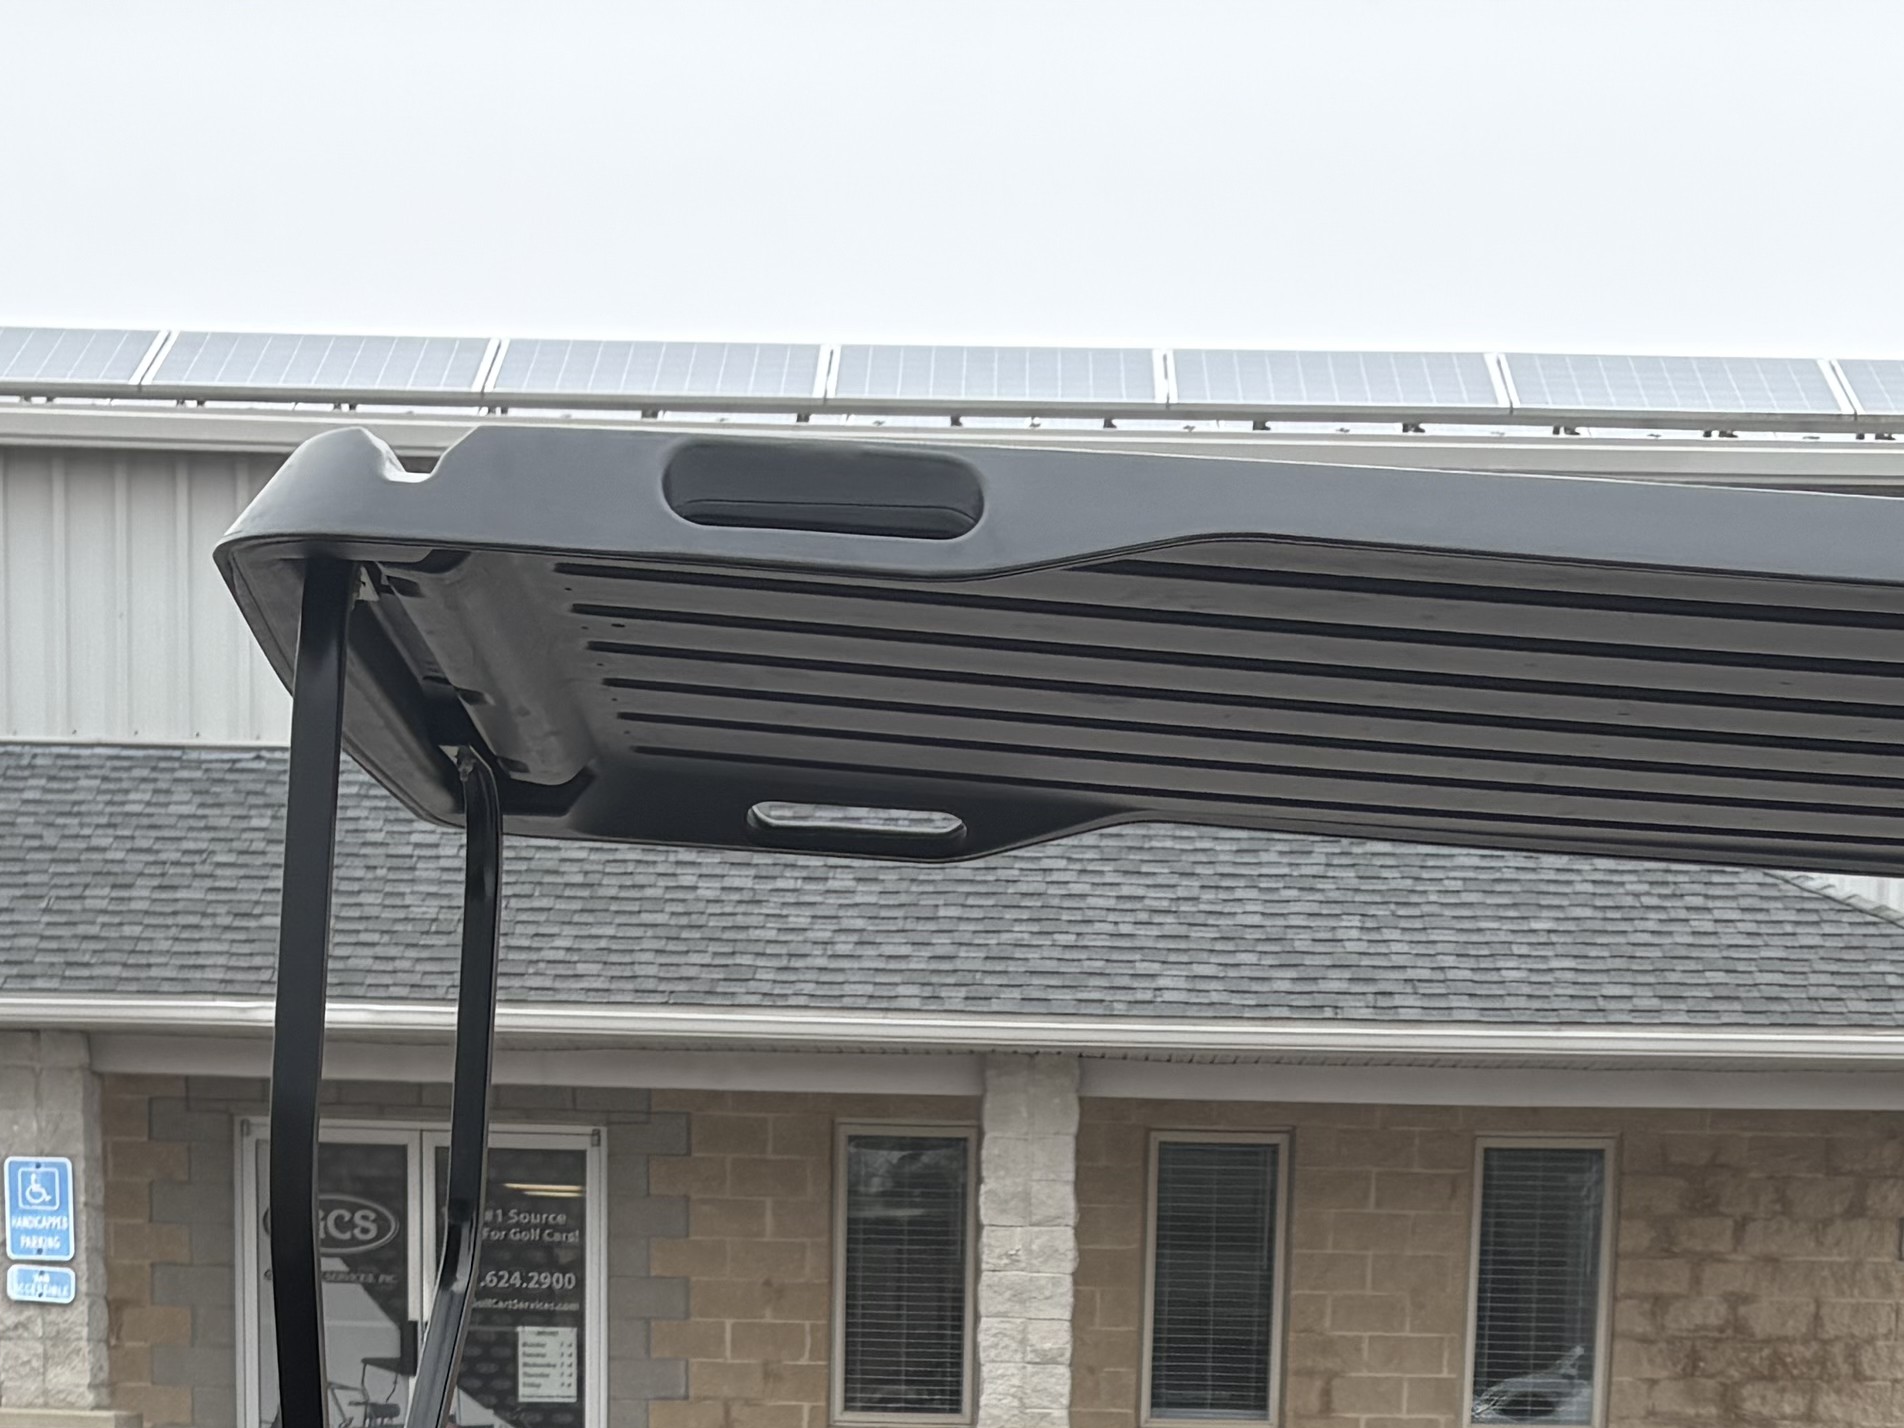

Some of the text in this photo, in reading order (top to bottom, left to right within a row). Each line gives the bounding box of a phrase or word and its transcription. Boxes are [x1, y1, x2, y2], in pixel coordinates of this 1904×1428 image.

[319, 1208, 379, 1241] CS
[507, 1209, 567, 1225] Source
[20, 1235, 61, 1249] PARKING
[482, 1227, 580, 1243] For Golf Cars!
